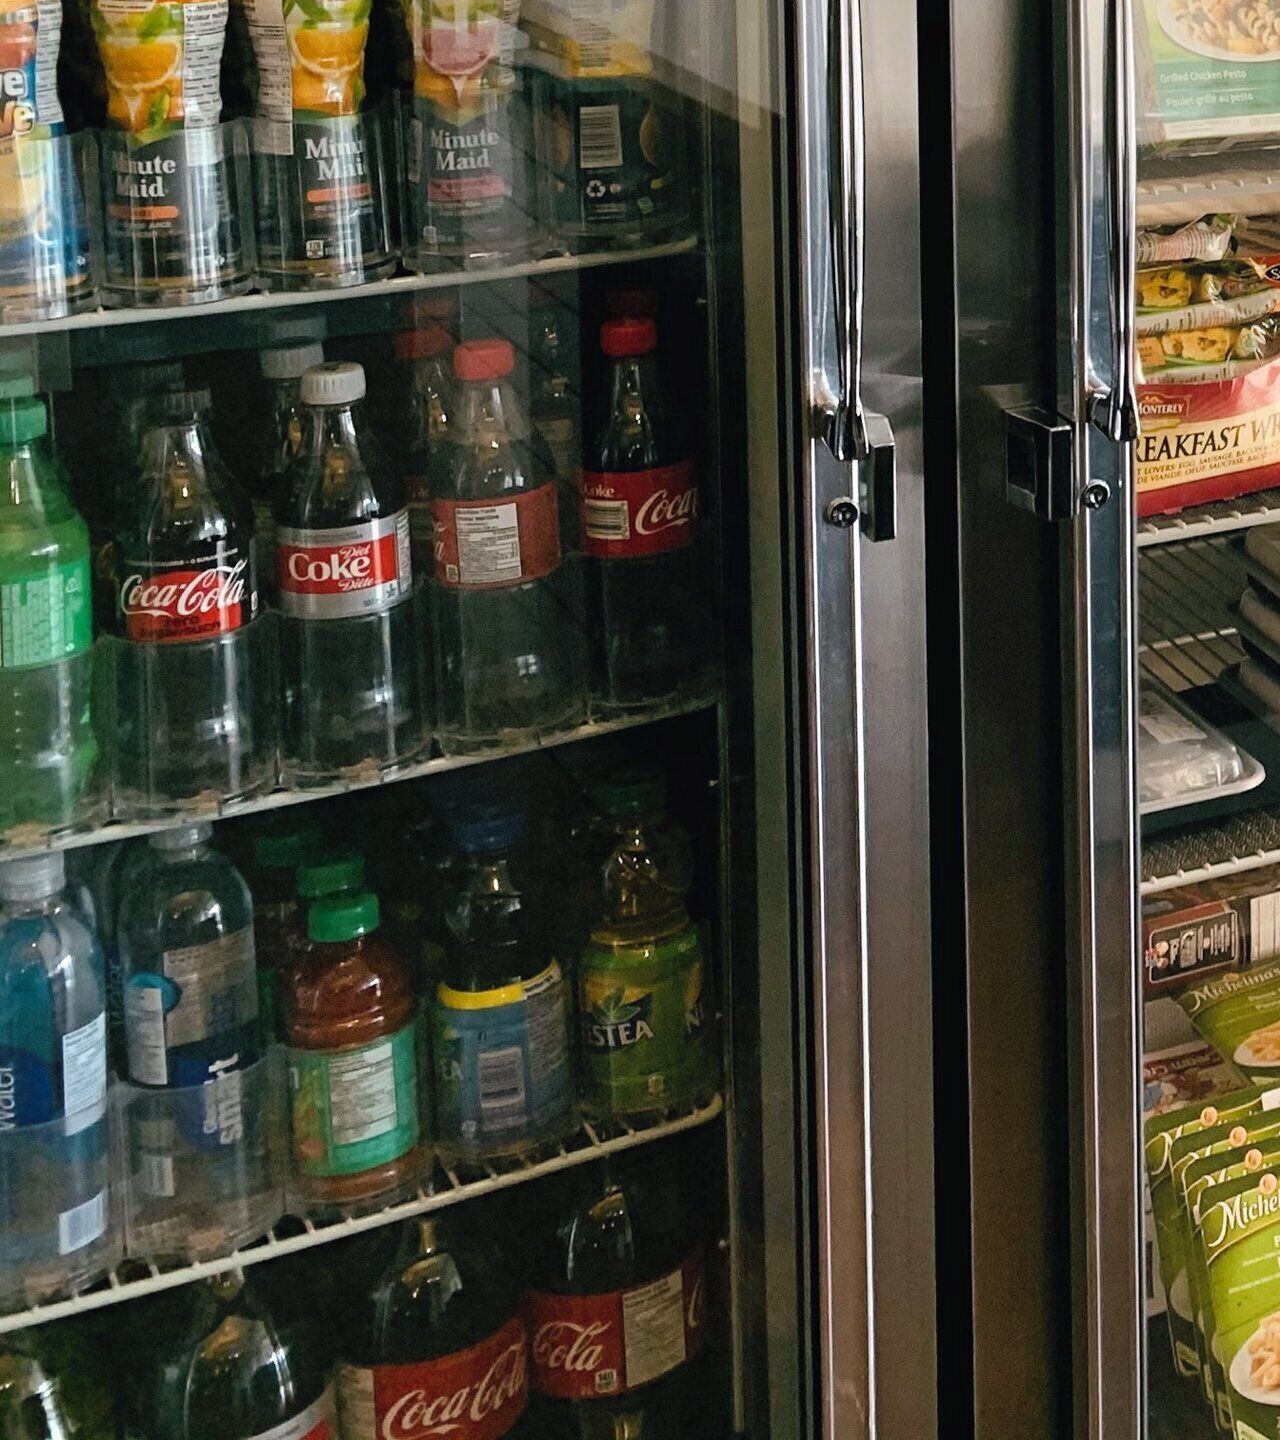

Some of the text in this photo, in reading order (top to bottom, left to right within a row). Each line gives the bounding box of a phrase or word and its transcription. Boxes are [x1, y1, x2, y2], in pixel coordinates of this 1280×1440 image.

[1160, 70, 1247, 84] Grilled Chicken Pesto
[1166, 95, 1194, 107] Poulet
[1219, 94, 1230, 103] au
[1231, 92, 1254, 105] pesto
[430, 129, 499, 150] Minute
[435, 148, 490, 171] Maid
[1137, 403, 1185, 415] MONTEREY
[1136, 423, 1246, 462] REAKFAST
[339, 545, 370, 560] Diet
[288, 553, 370, 582] Coke
[120, 559, 248, 617] Coca-Cola
[589, 1021, 654, 1048] STEA
[533, 1320, 611, 1371] Cola
